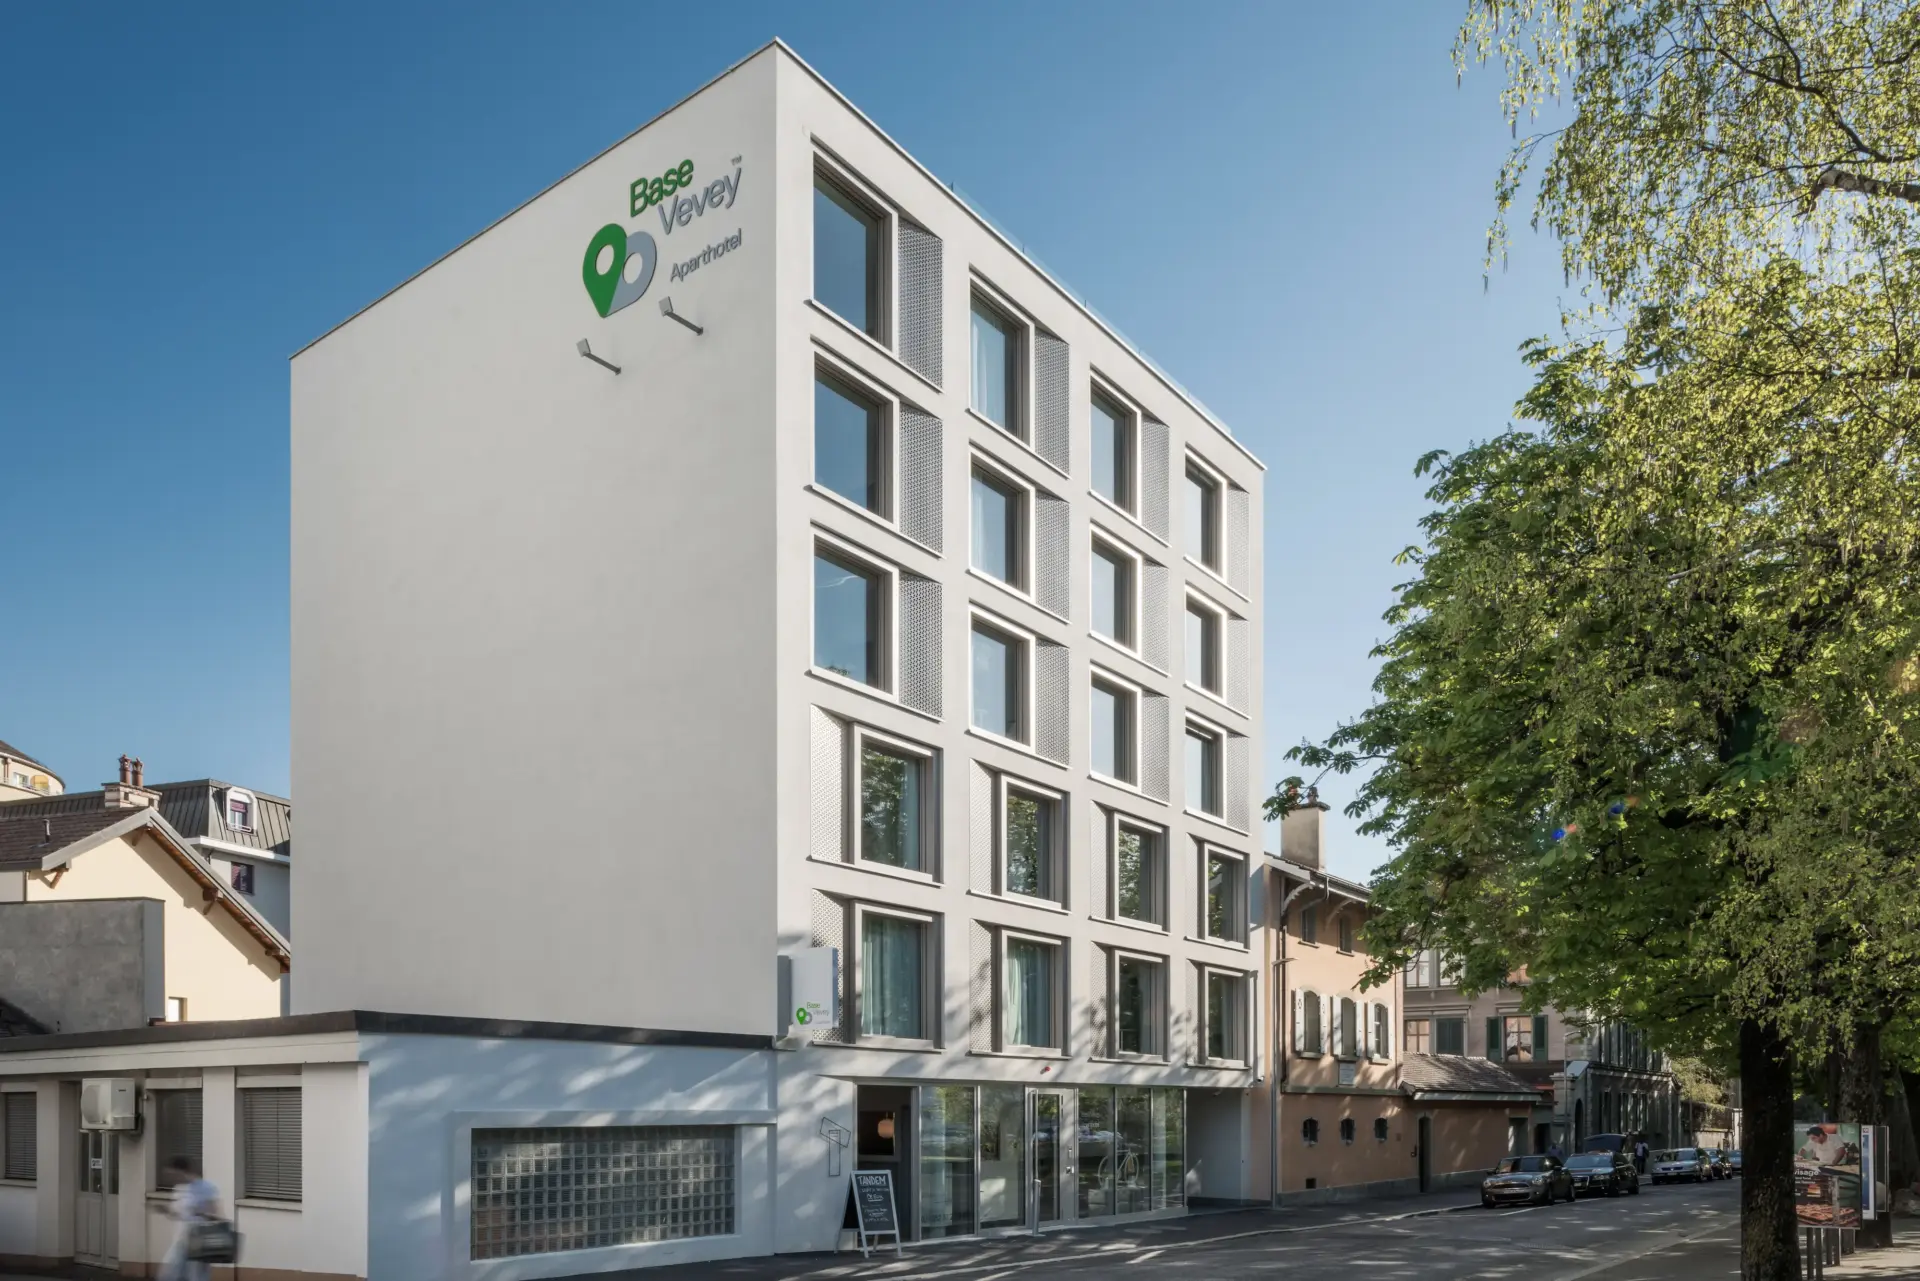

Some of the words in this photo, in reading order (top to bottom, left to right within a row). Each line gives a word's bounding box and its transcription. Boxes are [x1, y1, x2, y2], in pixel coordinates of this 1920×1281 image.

[630, 159, 694, 218] Base
[657, 167, 742, 235] Vevey
[670, 228, 742, 282] Aparthotel
[857, 1175, 887, 1186] TANDEM
